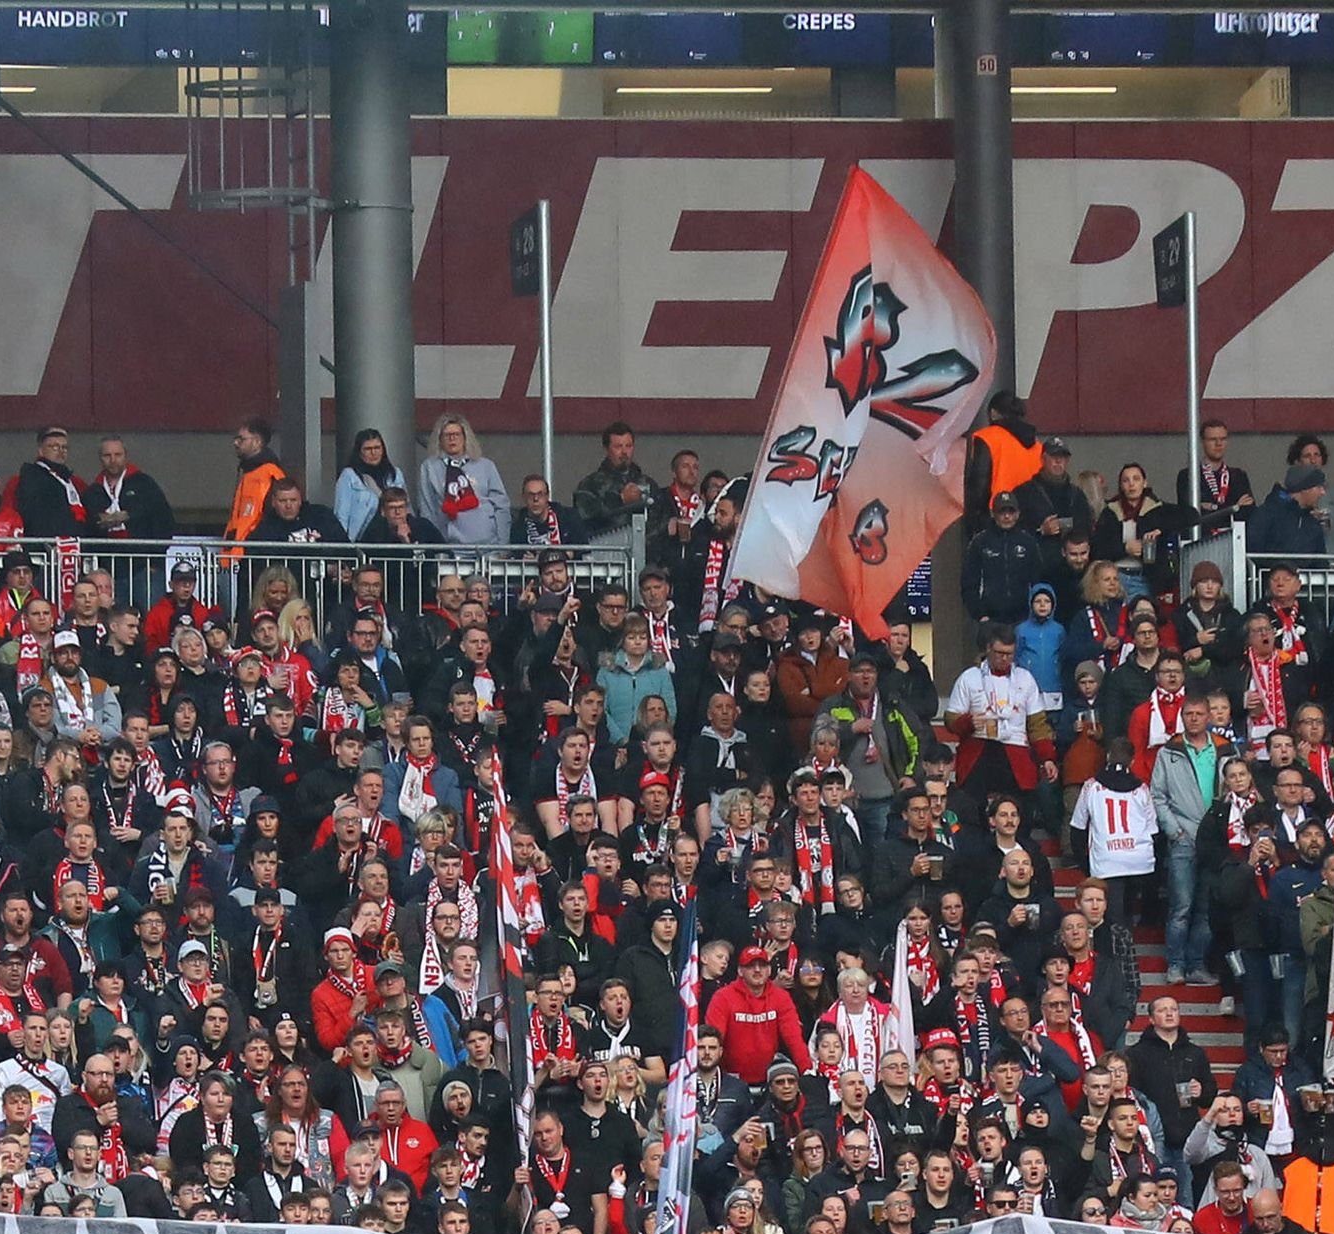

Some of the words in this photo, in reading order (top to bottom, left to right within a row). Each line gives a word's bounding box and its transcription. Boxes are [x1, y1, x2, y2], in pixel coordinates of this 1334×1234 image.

[18, 9, 128, 28] HANDBROT
[783, 12, 856, 31] CREPES
[978, 57, 996, 73] 50
[1105, 799, 1129, 834] 11
[1106, 836, 1135, 851] WERNER
